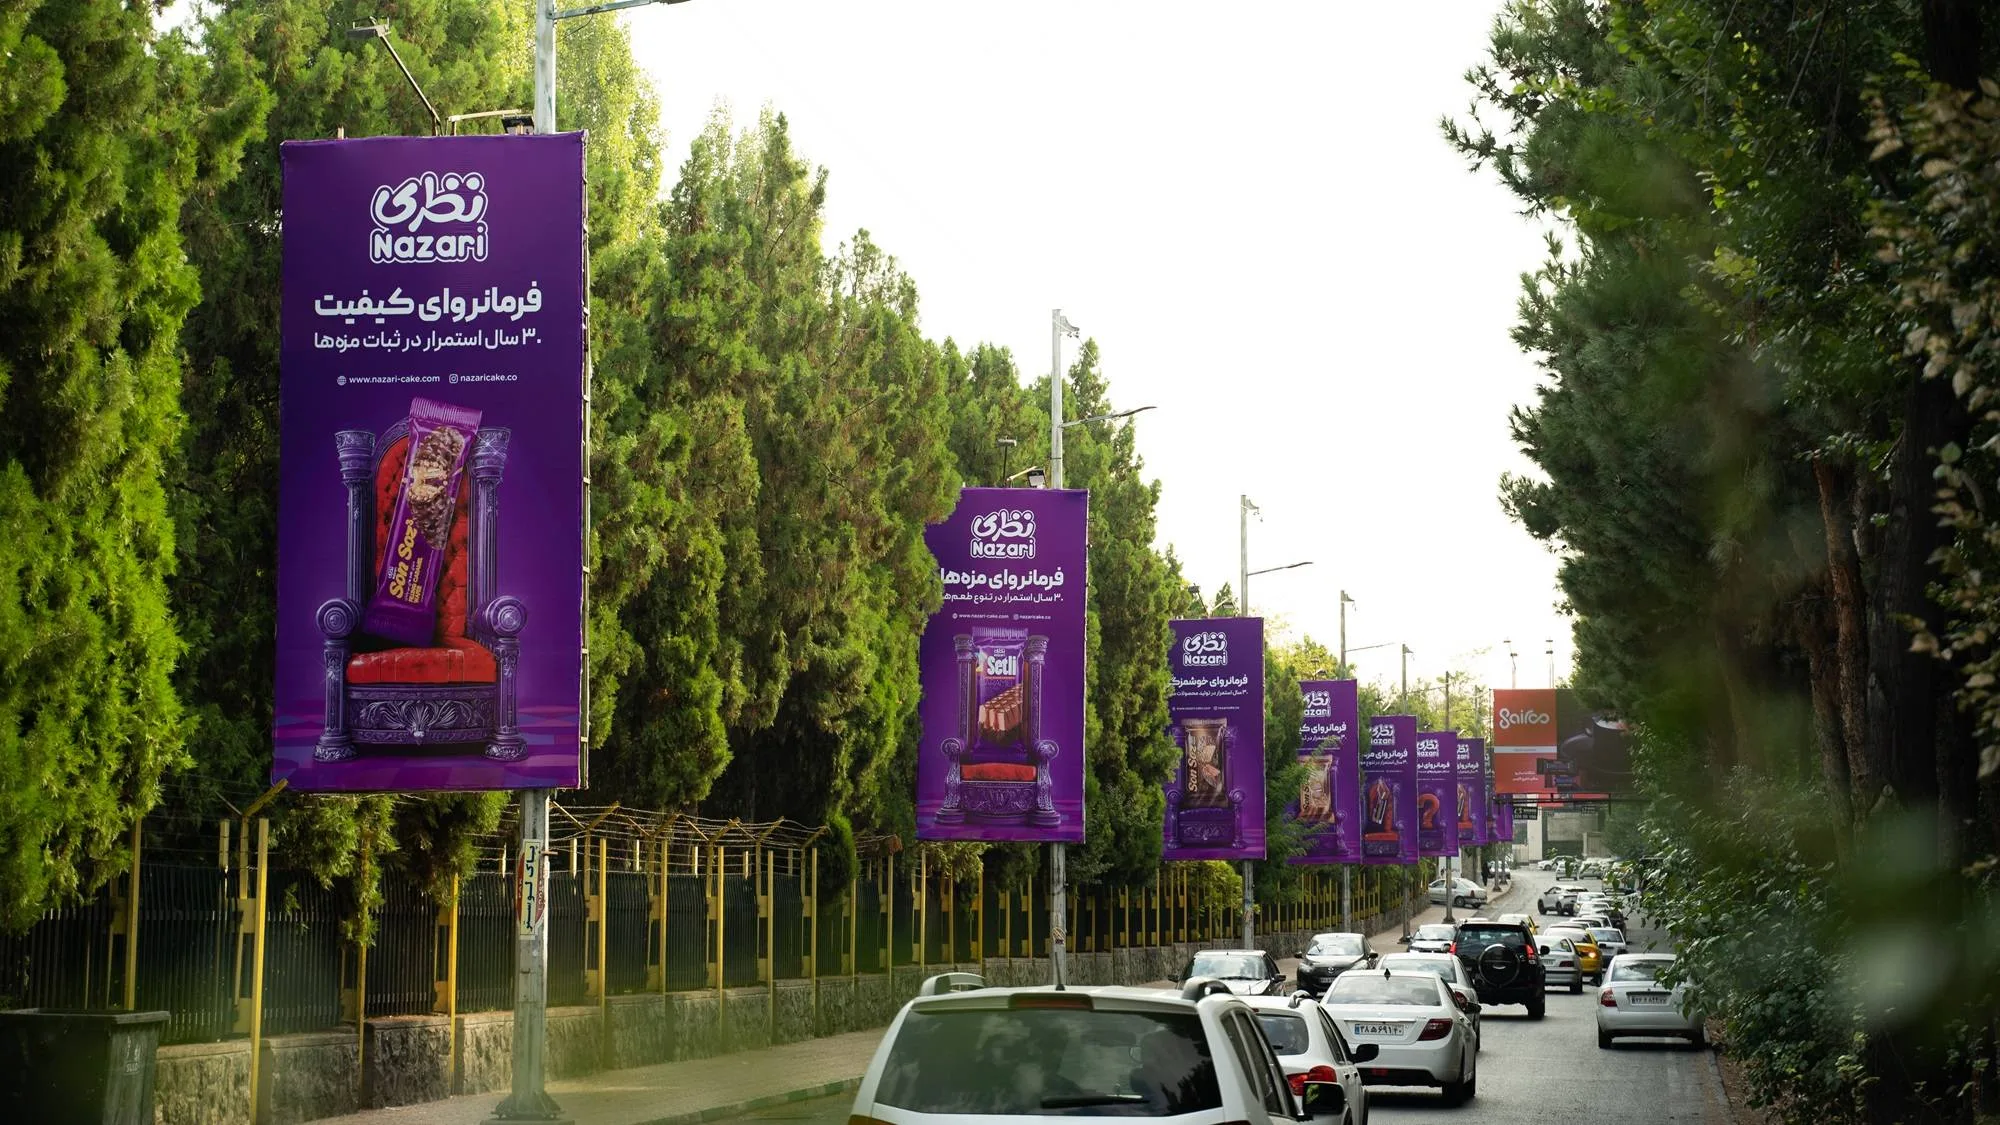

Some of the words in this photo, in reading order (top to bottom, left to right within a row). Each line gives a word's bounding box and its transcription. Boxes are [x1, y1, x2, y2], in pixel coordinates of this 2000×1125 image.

[373, 174, 485, 233] نظری
[373, 226, 485, 260] Nazari
[315, 287, 415, 325] کیفیت
[418, 281, 542, 322] فرمانروای
[363, 330, 401, 352] ثبات
[402, 335, 422, 352] در
[423, 329, 482, 352] استمرار
[484, 329, 519, 350] سال
[349, 374, 441, 384] www.nazari-cake.com
[460, 373, 518, 383] nazaricake.co
[974, 510, 1035, 542] نظری
[973, 539, 1034, 557] Nazari
[389, 561, 409, 599] Son
[988, 566, 1064, 591] فرمانروای
[973, 593, 994, 604] تنوع
[993, 595, 1003, 603] در
[1003, 592, 1033, 603] استمرار
[1033, 592, 1053, 603] سال
[1184, 633, 1226, 655] نظری
[987, 655, 1017, 676] Setli
[1184, 651, 1227, 665] Nazari
[1209, 673, 1249, 688] فرمانروای
[1303, 706, 1331, 716] azari
[1310, 722, 1347, 734] فرمانروای
[1188, 769, 1198, 792] Son
[525, 844, 538, 878] پاک
